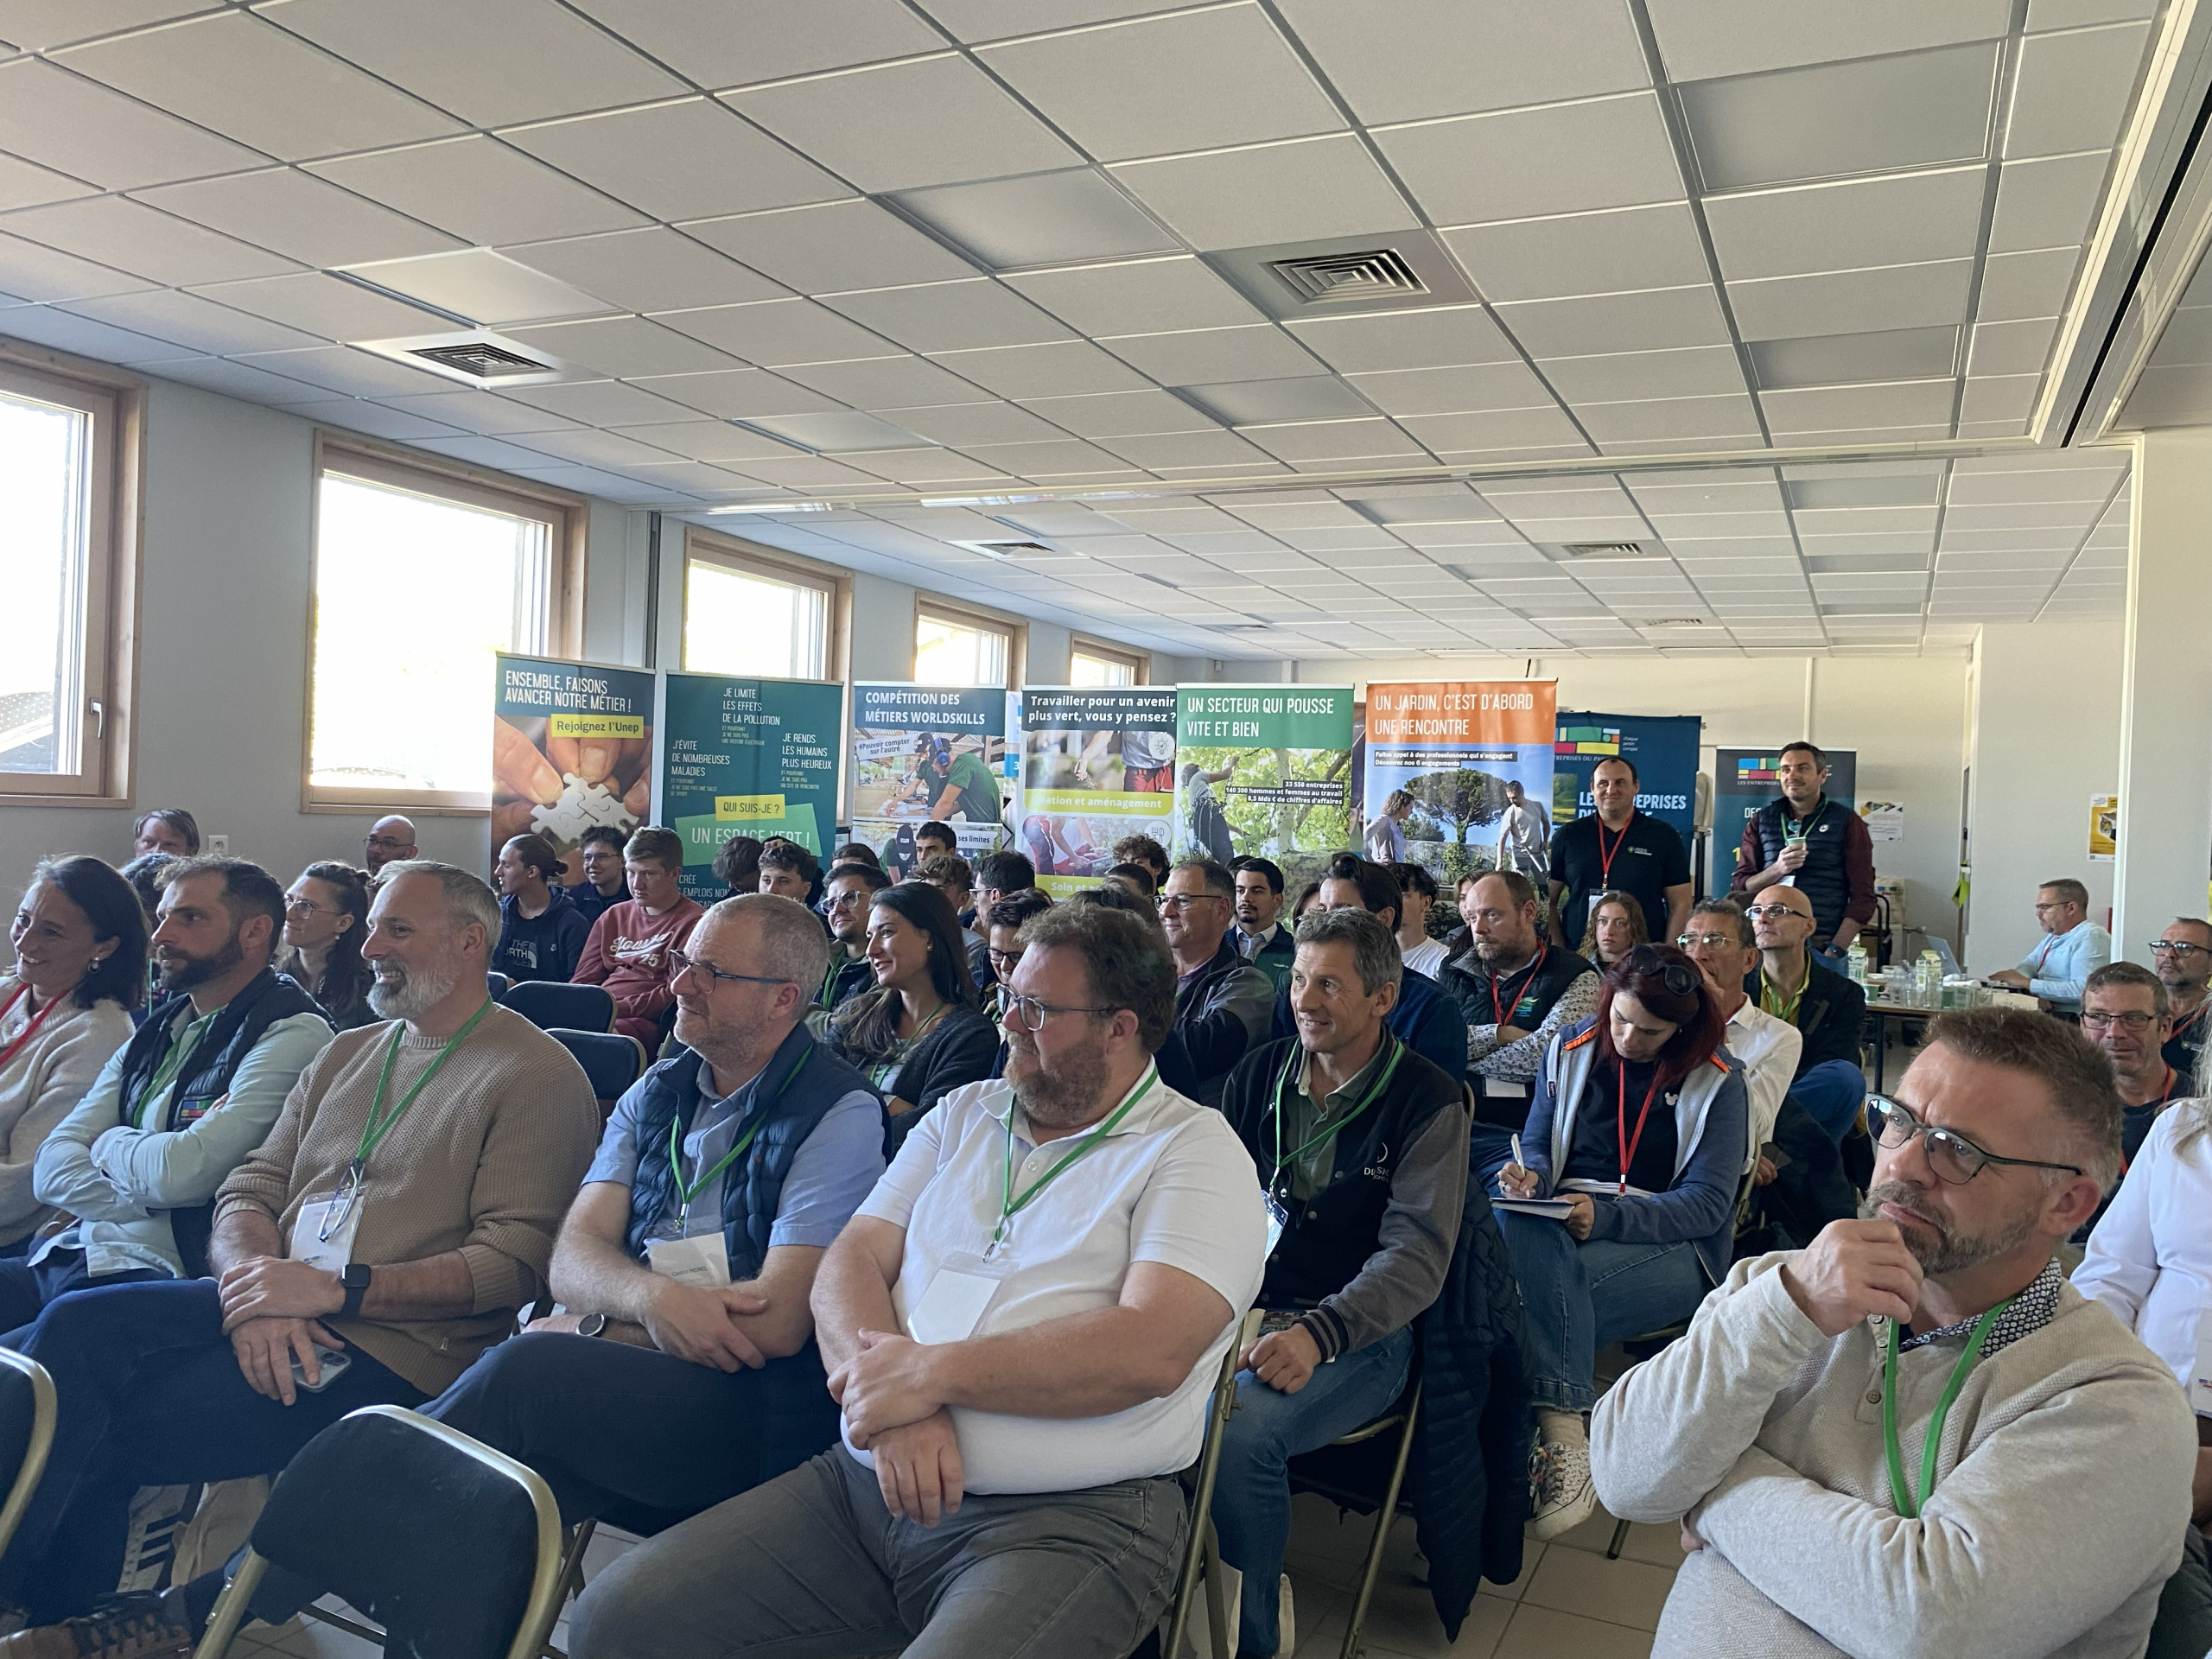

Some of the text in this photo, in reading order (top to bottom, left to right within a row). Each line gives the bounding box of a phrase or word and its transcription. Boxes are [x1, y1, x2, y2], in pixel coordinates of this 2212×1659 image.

[505, 670, 607, 695] ENSEMBLE, FAISONS
[505, 687, 632, 712] AVANCER NOTRE MÉTIER !
[723, 688, 756, 699] JE LIMITE
[865, 690, 960, 705] COMPÉTITION DES
[723, 700, 762, 712] LES EFFETS
[1031, 696, 1086, 707] Travailler
[1088, 699, 1116, 709] pour
[1136, 696, 1176, 708] avenir
[1187, 697, 1334, 715] UN SECTEUR QUI POUSSE
[1375, 694, 1533, 712] UN JARDIN, C'EST D'ABORD
[722, 713, 780, 726] DE LA POLLUTION
[865, 709, 985, 725] MÉTIERS WORLDSKILLS
[1028, 710, 1177, 724] plus vert, vous y pensez ?
[556, 721, 639, 734] Rejoignez l'Unep
[1187, 721, 1260, 737] VITE ET BIEN
[1375, 720, 1469, 734] UNE RENCONTRE
[672, 739, 697, 750] J'ÉVITE
[783, 733, 816, 743] JE RENDS
[885, 739, 910, 747] compter
[782, 746, 828, 757] LES HUMAINS
[671, 753, 730, 765] DE NOMBREUSES
[782, 758, 832, 770] PLUS HEUREUX
[671, 766, 706, 777] MALADIES
[1074, 797, 1085, 805] et
[1087, 797, 1162, 810] aménagement
[1580, 791, 1597, 806] LE
[723, 802, 779, 813] QUI SUIS-JE ?
[692, 828, 710, 843] UN
[806, 832, 810, 848] !
[678, 874, 697, 885] CRÉE
[683, 887, 714, 898] EMPLOIS
[1051, 882, 1073, 891] Soin
[512, 938, 530, 950] THE
[639, 953, 660, 967] 25
